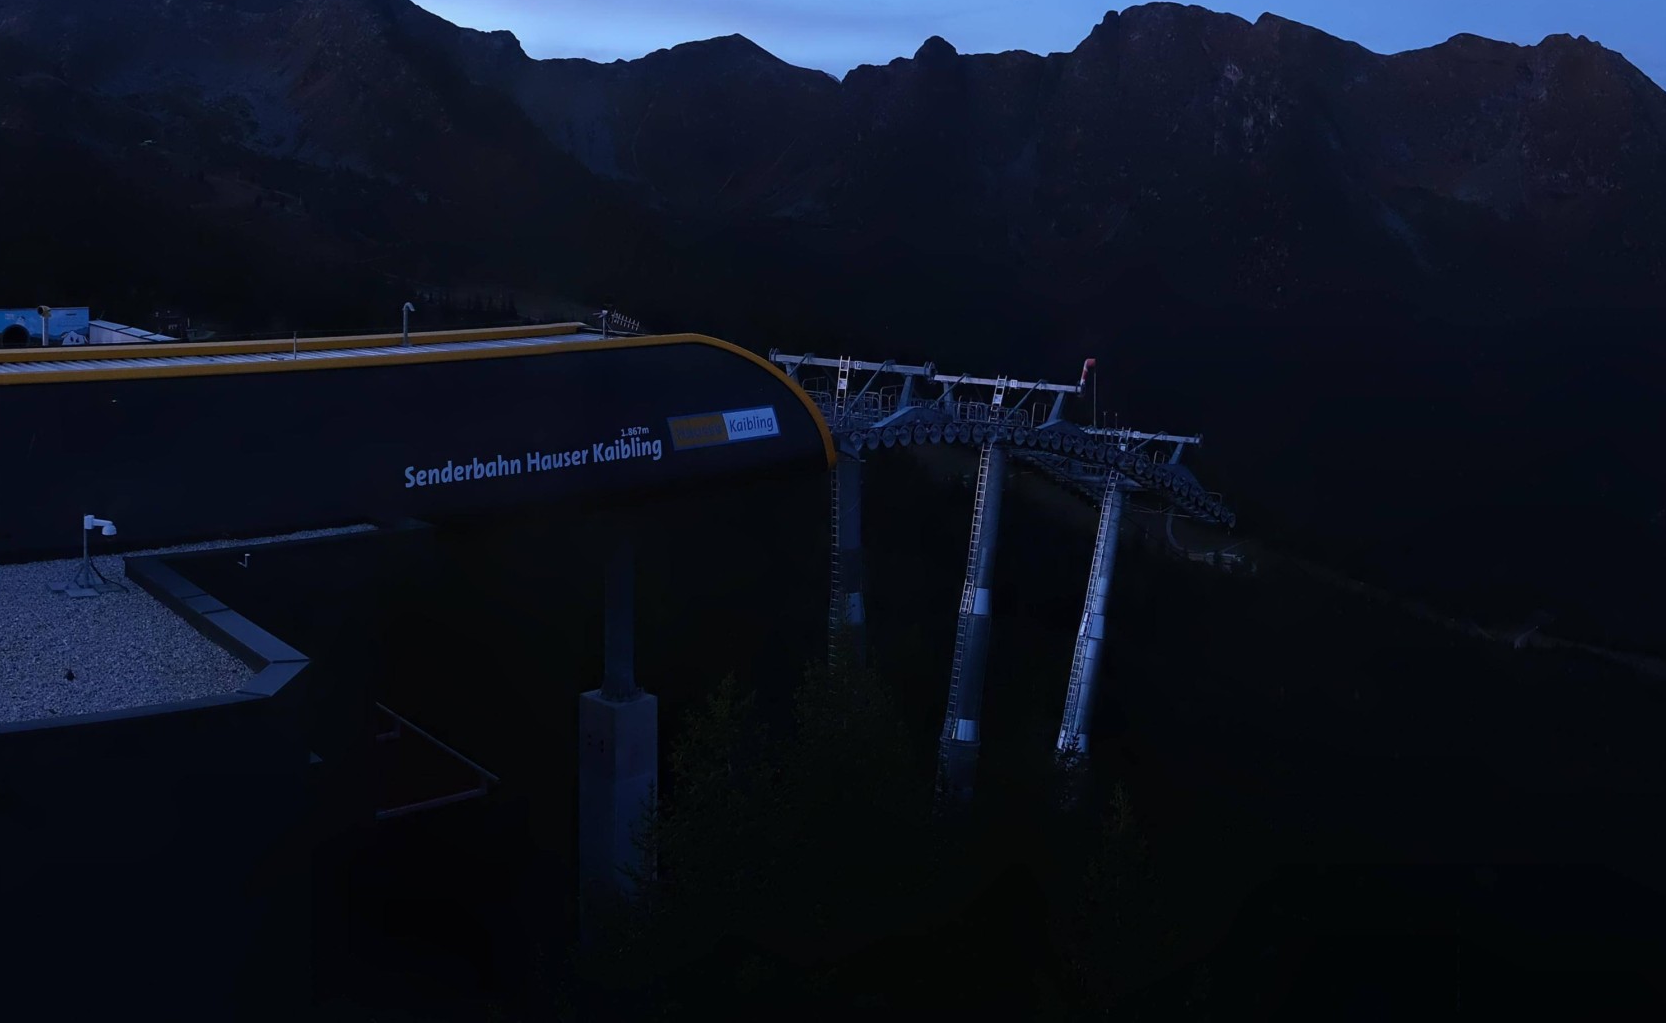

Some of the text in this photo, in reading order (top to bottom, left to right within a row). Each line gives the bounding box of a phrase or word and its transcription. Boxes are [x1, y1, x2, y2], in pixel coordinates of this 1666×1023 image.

[620, 425, 650, 437] 1.867m
[729, 416, 774, 433] Kaibling
[404, 435, 663, 489] Senderbahn Hauser Kaibling
